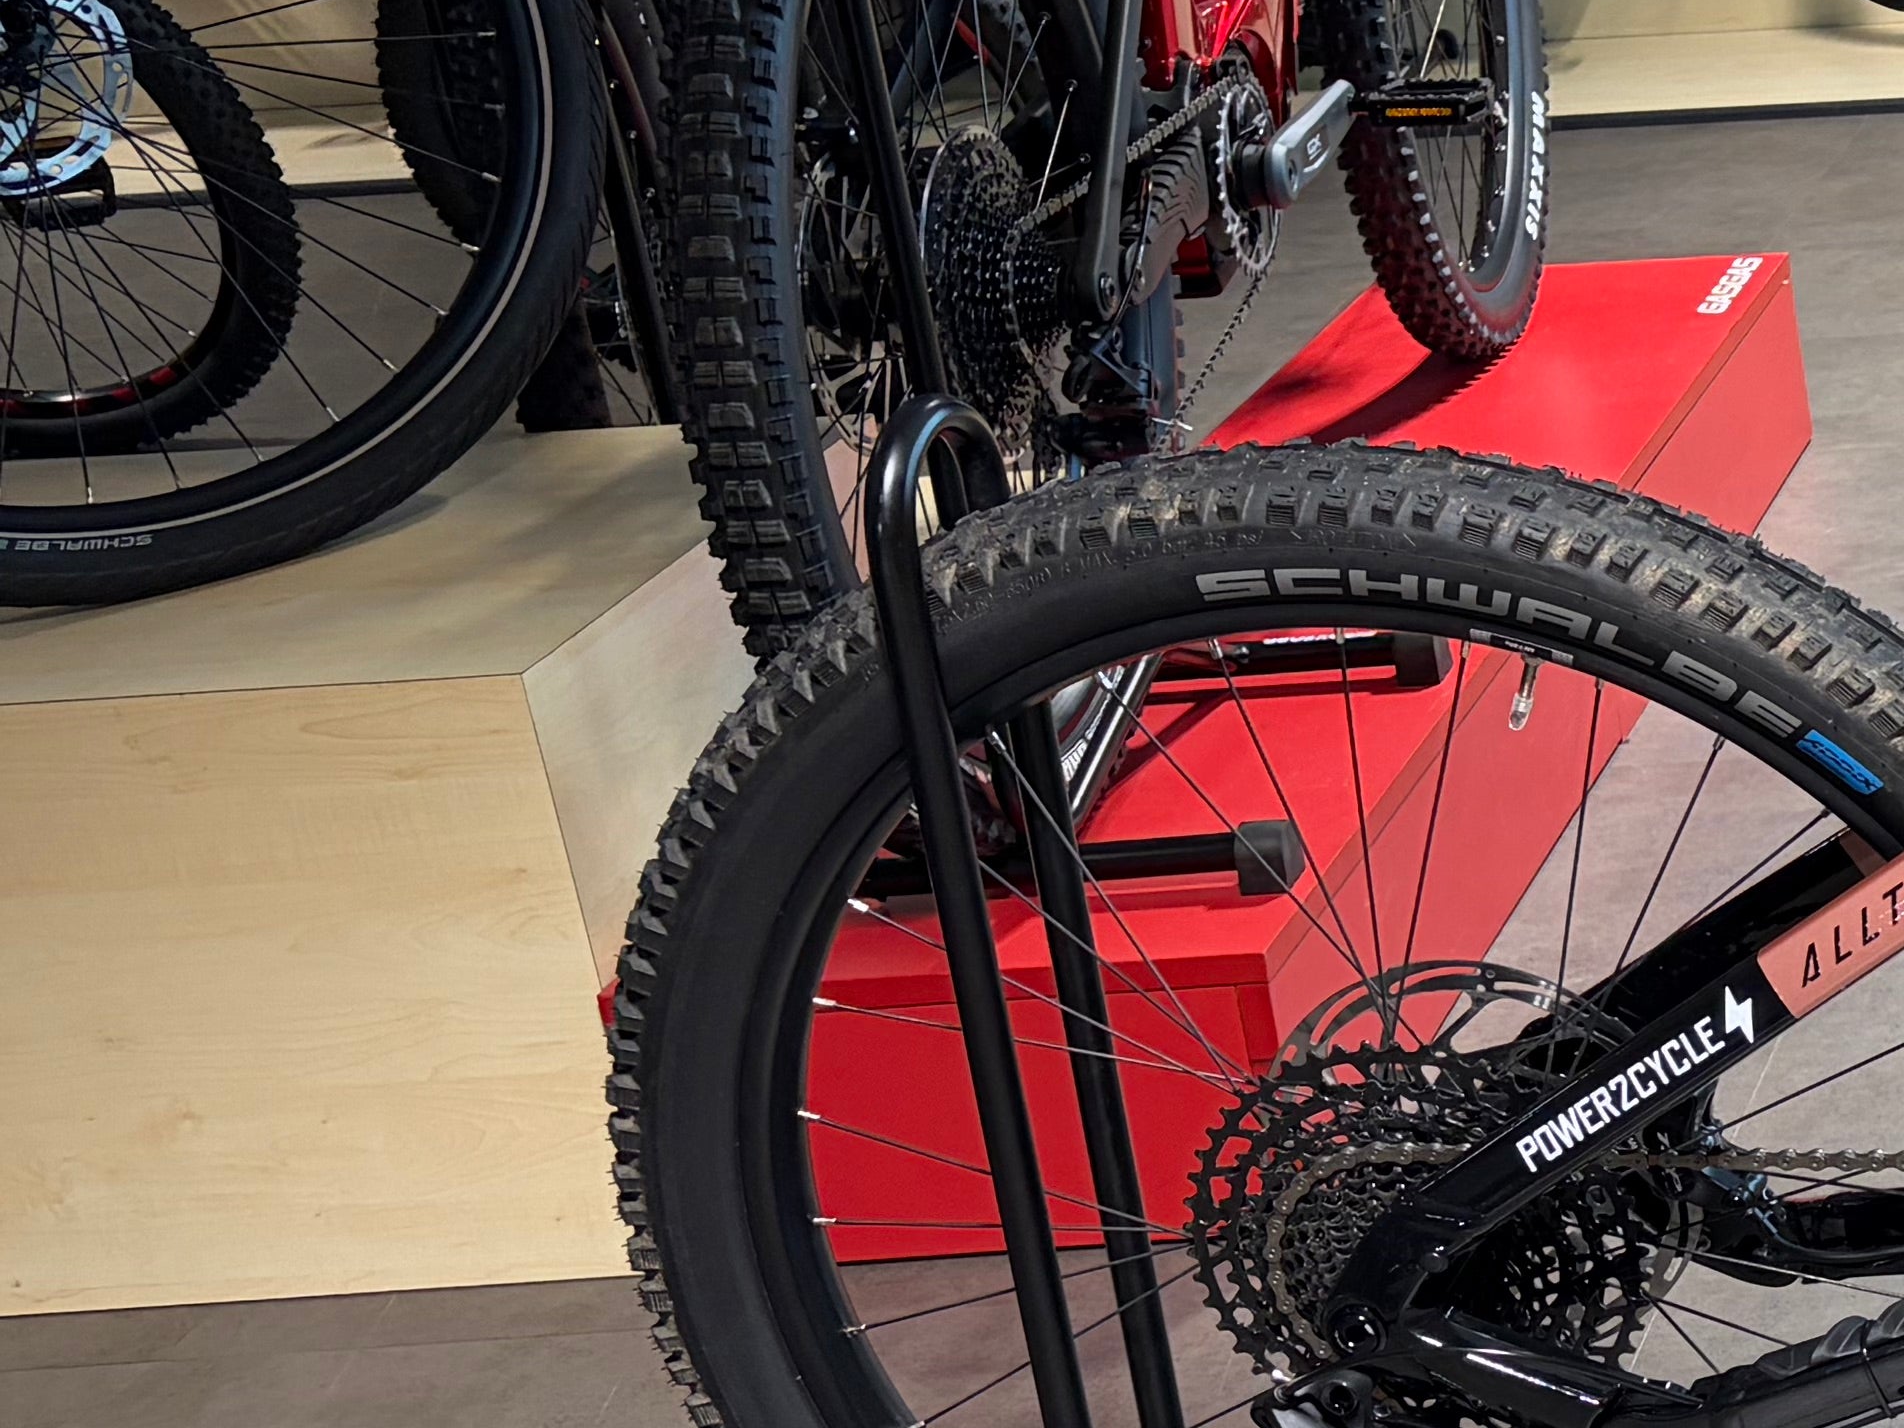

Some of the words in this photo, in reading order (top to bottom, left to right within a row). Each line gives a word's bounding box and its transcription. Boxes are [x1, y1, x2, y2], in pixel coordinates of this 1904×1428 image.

[1525, 90, 1548, 242] MAXXIS
[1696, 254, 1764, 315] GASGAS
[1193, 567, 1802, 740] SCHWALBE
[1515, 1017, 1722, 1175] POWER2CYCLE
